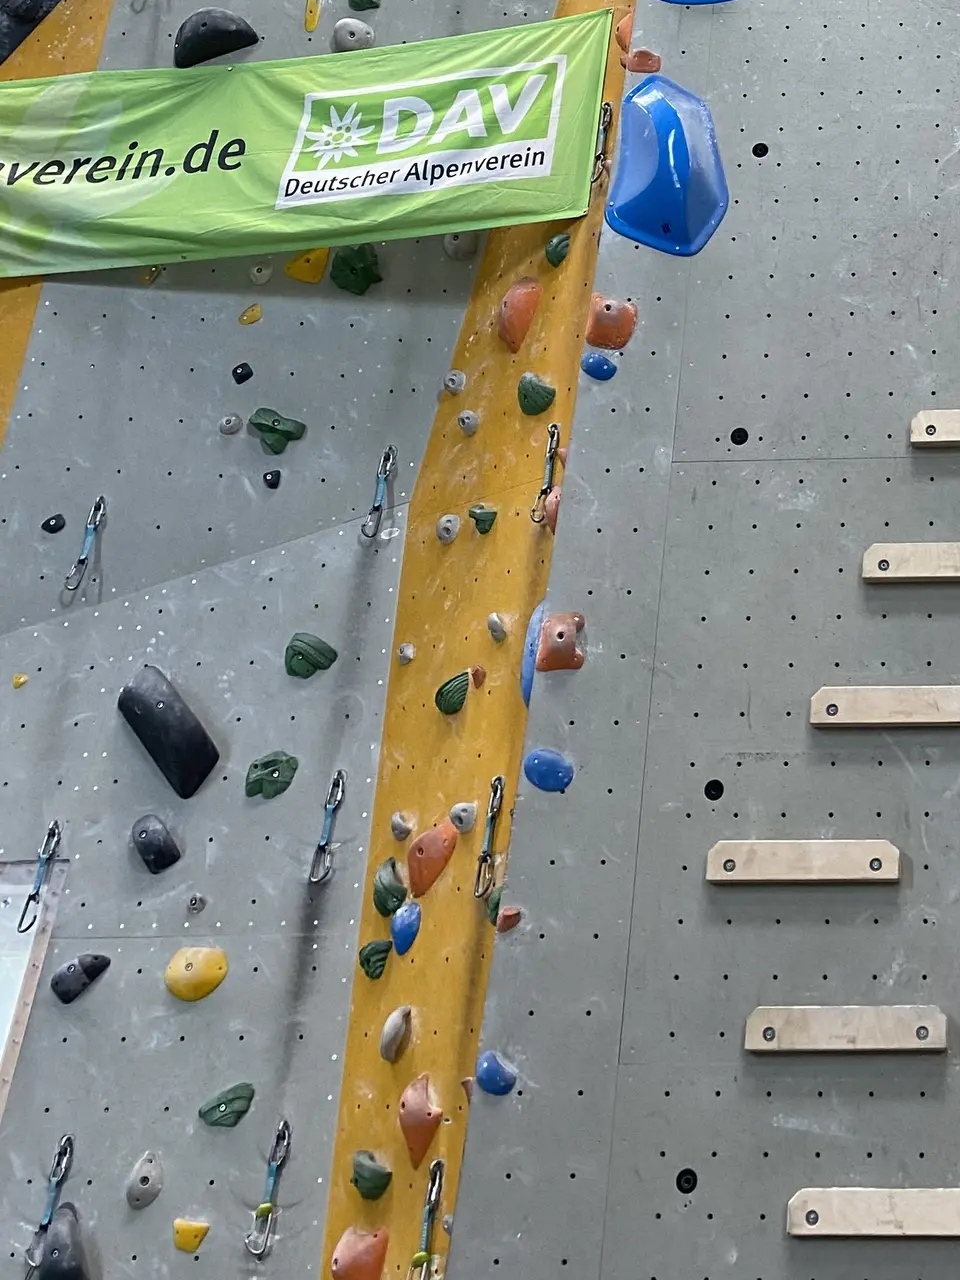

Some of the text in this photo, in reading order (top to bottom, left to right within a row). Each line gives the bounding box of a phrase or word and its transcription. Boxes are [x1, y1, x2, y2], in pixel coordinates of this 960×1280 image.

[376, 74, 548, 155] DAV
[284, 147, 545, 198] Deutscher Alpenverein
